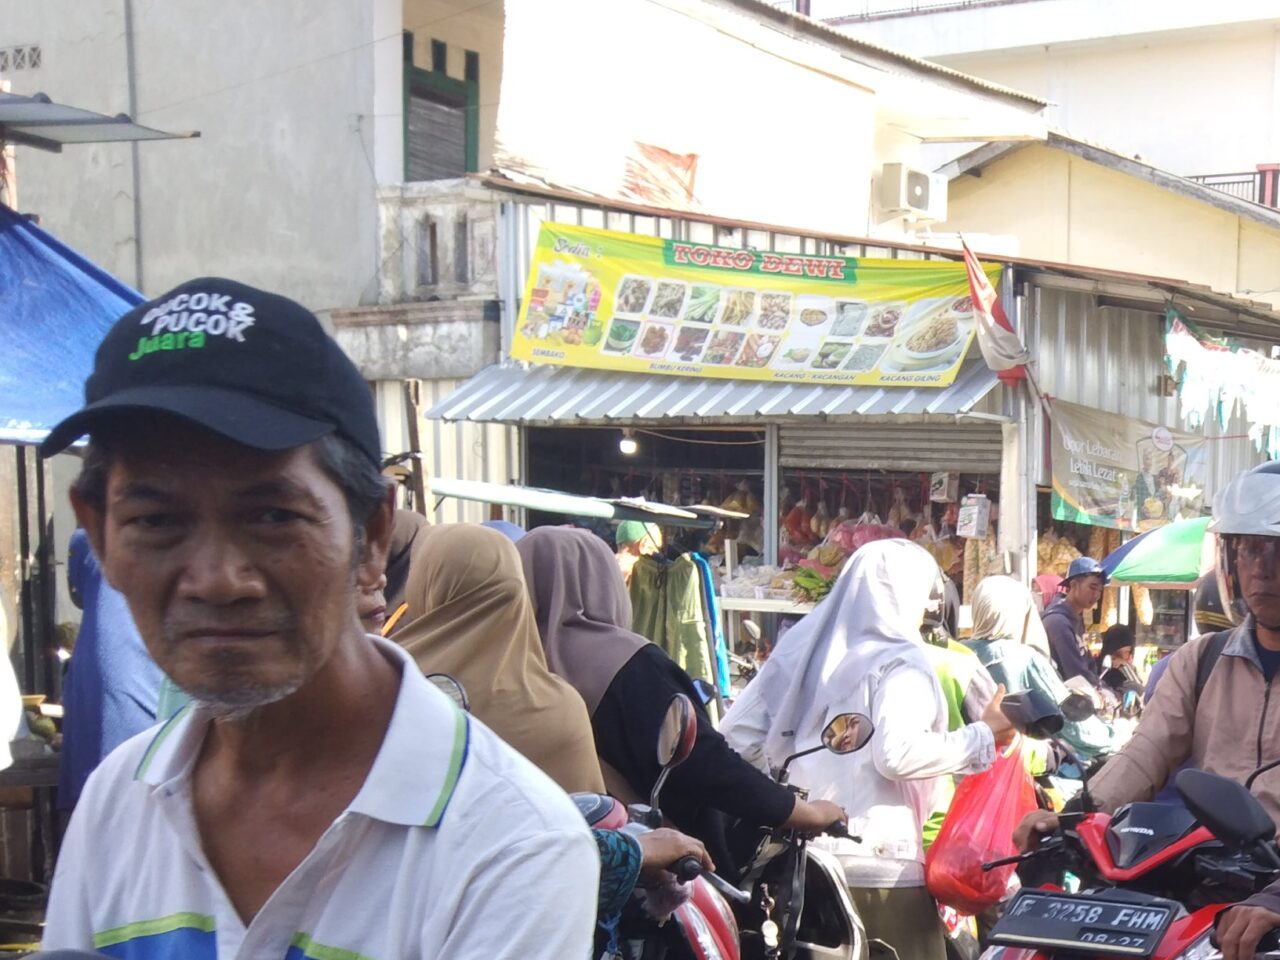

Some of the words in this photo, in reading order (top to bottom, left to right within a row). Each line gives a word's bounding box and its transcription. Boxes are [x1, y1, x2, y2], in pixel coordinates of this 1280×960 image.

[672, 243, 755, 270] TOKO
[760, 254, 846, 279] DEWI
[151, 311, 246, 342] PUCOK
[128, 331, 205, 360] Juara
[774, 372, 805, 380] KACANG
[811, 373, 856, 381] KACANGAN
[1093, 462, 1116, 481] Lezat
[1016, 900, 1036, 917] F
[1111, 909, 1164, 930] FHM
